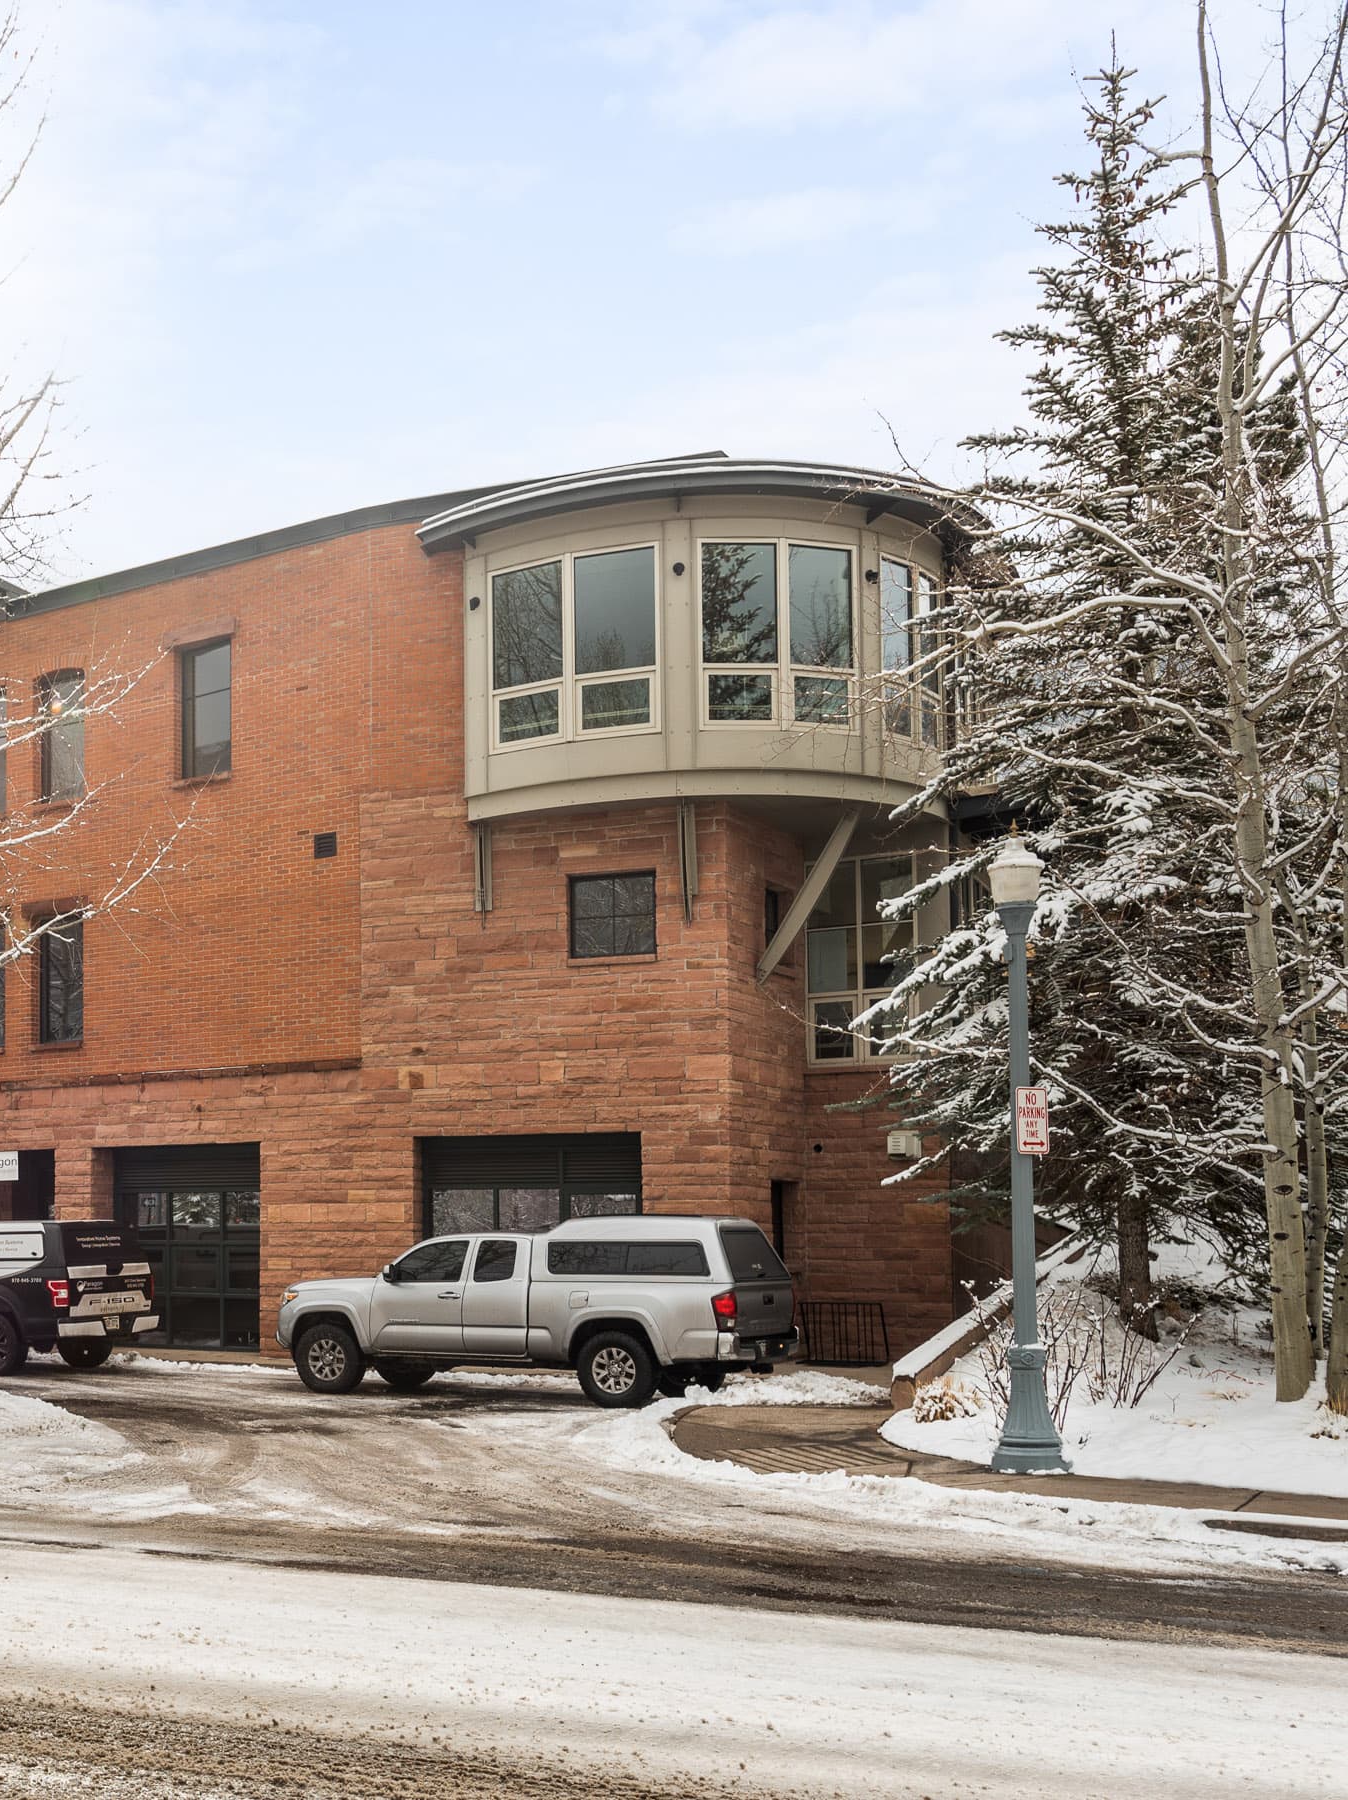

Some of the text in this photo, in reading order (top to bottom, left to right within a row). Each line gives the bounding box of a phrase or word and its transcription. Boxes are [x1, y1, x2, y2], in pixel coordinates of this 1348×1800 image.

[1025, 1093, 1037, 1105] NO
[1019, 1106, 1046, 1119] PARKING
[1025, 1120, 1038, 1129] ANY
[1025, 1130, 1039, 1139] TIME
[84, 1280, 104, 1288] Paragon
[89, 1296, 135, 1306] F-150
